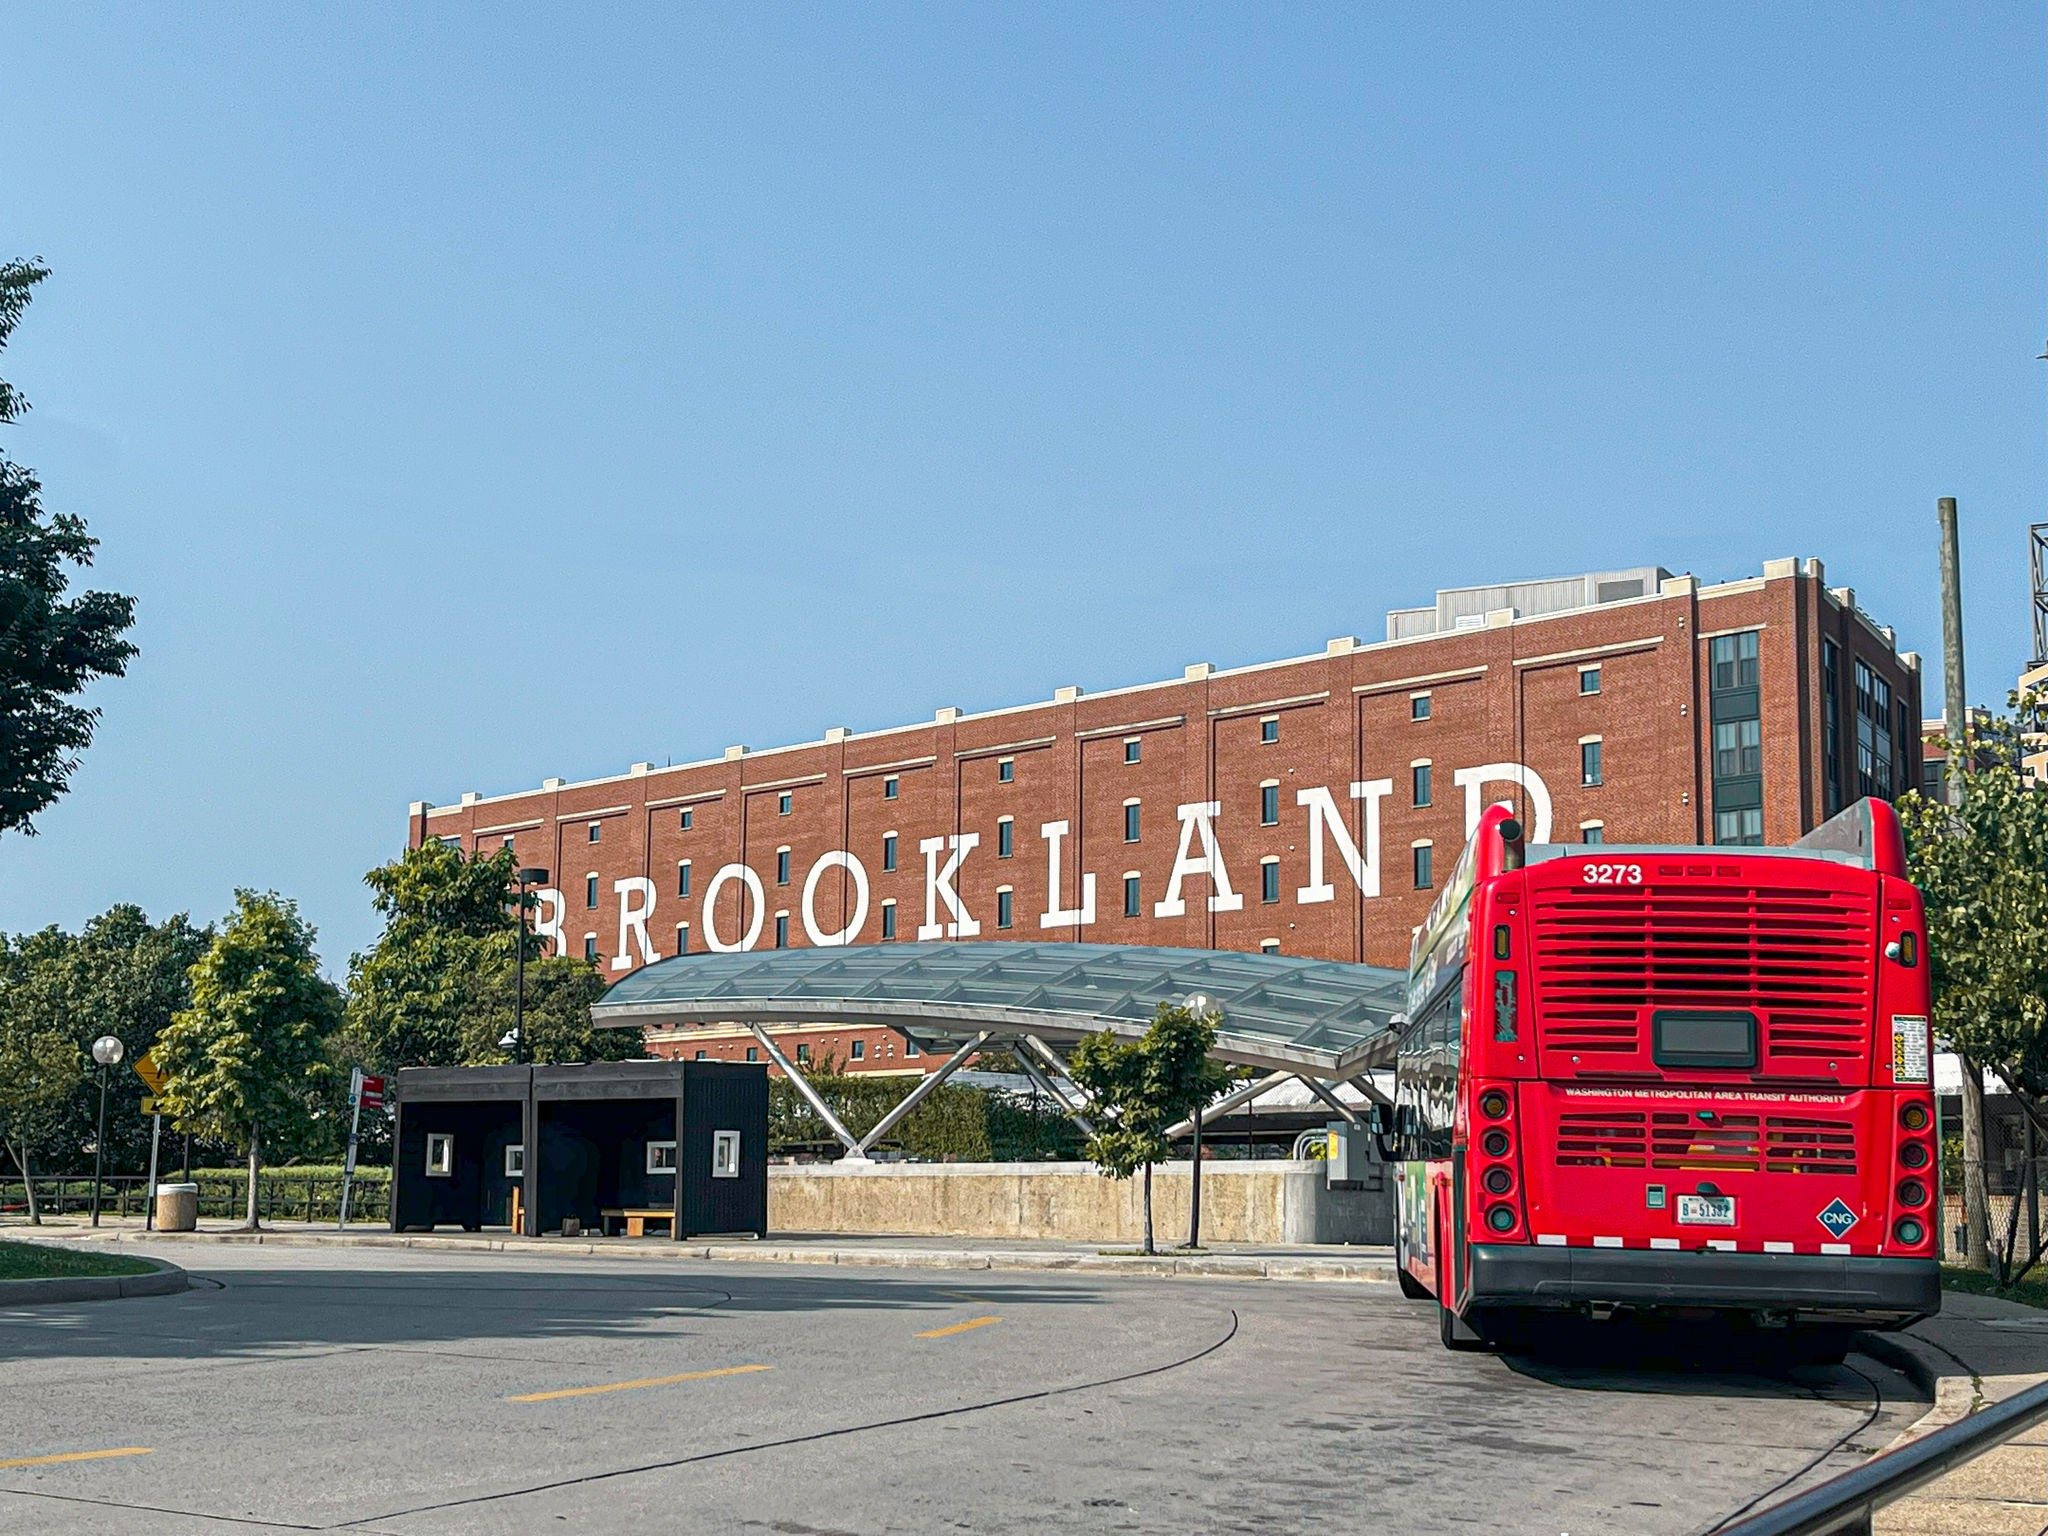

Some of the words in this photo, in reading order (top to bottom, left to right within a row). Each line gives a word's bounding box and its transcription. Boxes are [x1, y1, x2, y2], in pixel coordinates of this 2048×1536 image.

[531, 762, 1553, 970] BROOKLAND
[1583, 864, 1642, 884] 3273
[1565, 1088, 1632, 1098] WASHINGTON
[1634, 1090, 1712, 1099] METROPOLITAN
[1714, 1091, 1742, 1100] AREA
[1744, 1092, 1786, 1101] TRANSIT
[1788, 1093, 1847, 1103] AUTHORITY
[1823, 1212, 1853, 1224] CNG
